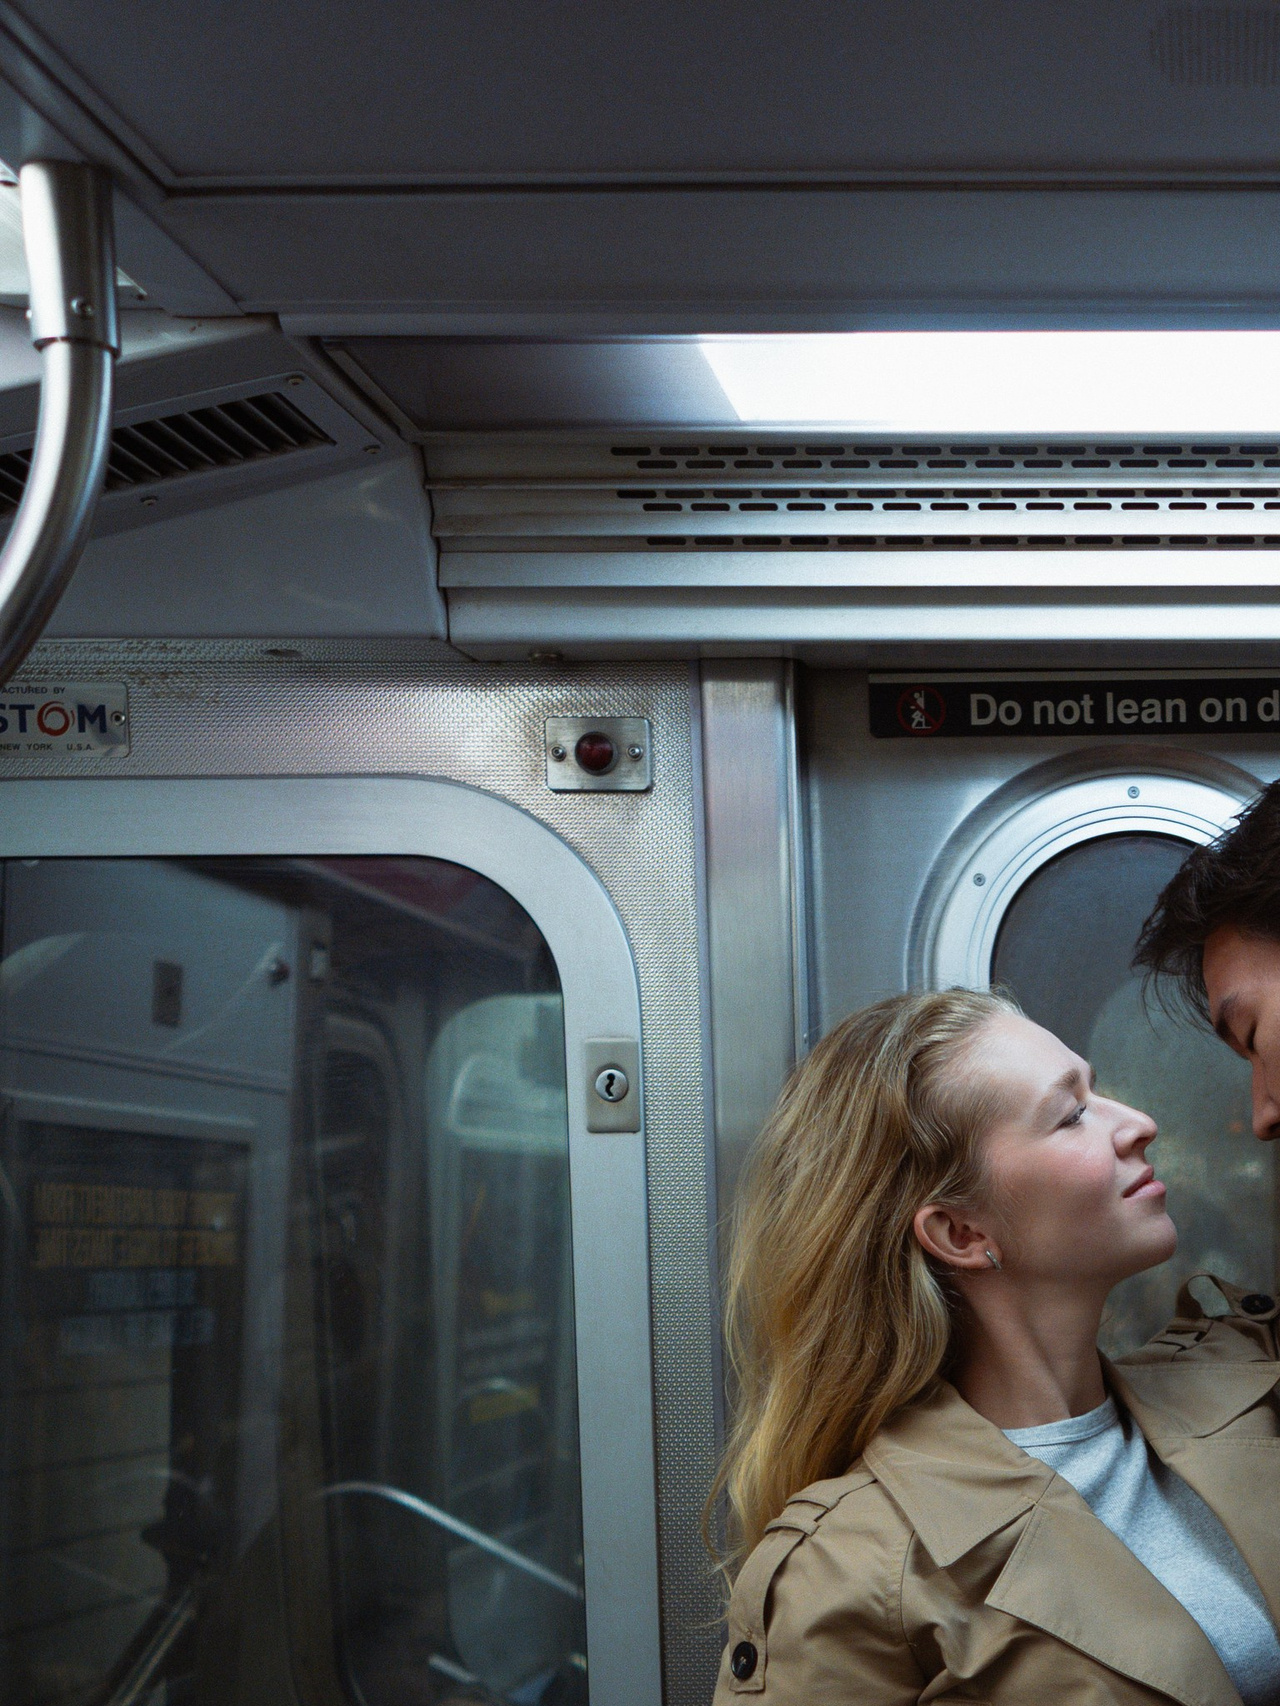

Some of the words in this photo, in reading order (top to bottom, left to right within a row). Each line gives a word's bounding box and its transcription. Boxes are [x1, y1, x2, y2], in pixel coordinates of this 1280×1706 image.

[53, 686, 66, 695] BY
[970, 693, 1022, 726] Do
[1033, 692, 1094, 725] not
[1106, 692, 1187, 724] lean
[1199, 697, 1247, 723] on
[26, 743, 53, 751] YORK
